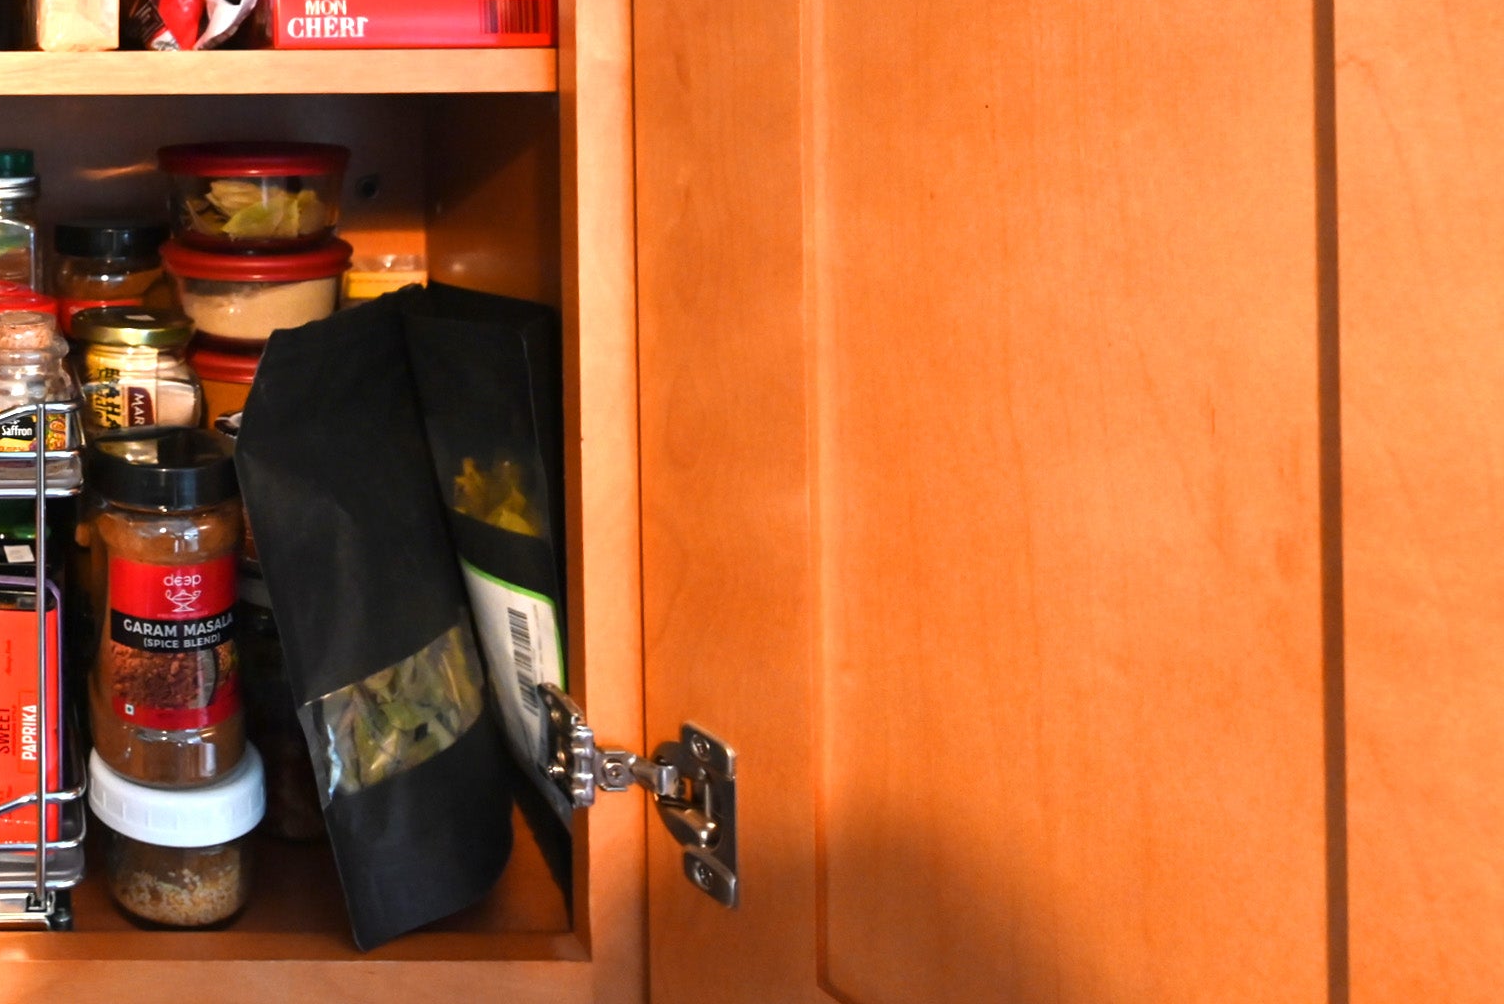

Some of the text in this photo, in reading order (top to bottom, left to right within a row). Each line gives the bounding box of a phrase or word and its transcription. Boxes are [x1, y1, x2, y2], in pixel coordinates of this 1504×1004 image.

[304, 0, 347, 16] MON
[1, 424, 33, 436] Saffron
[163, 573, 202, 587] deep
[123, 613, 234, 637] GARAM MASALA
[143, 633, 220, 648] (SPICE BLEND)
[21, 704, 37, 761] PAPRIKA
